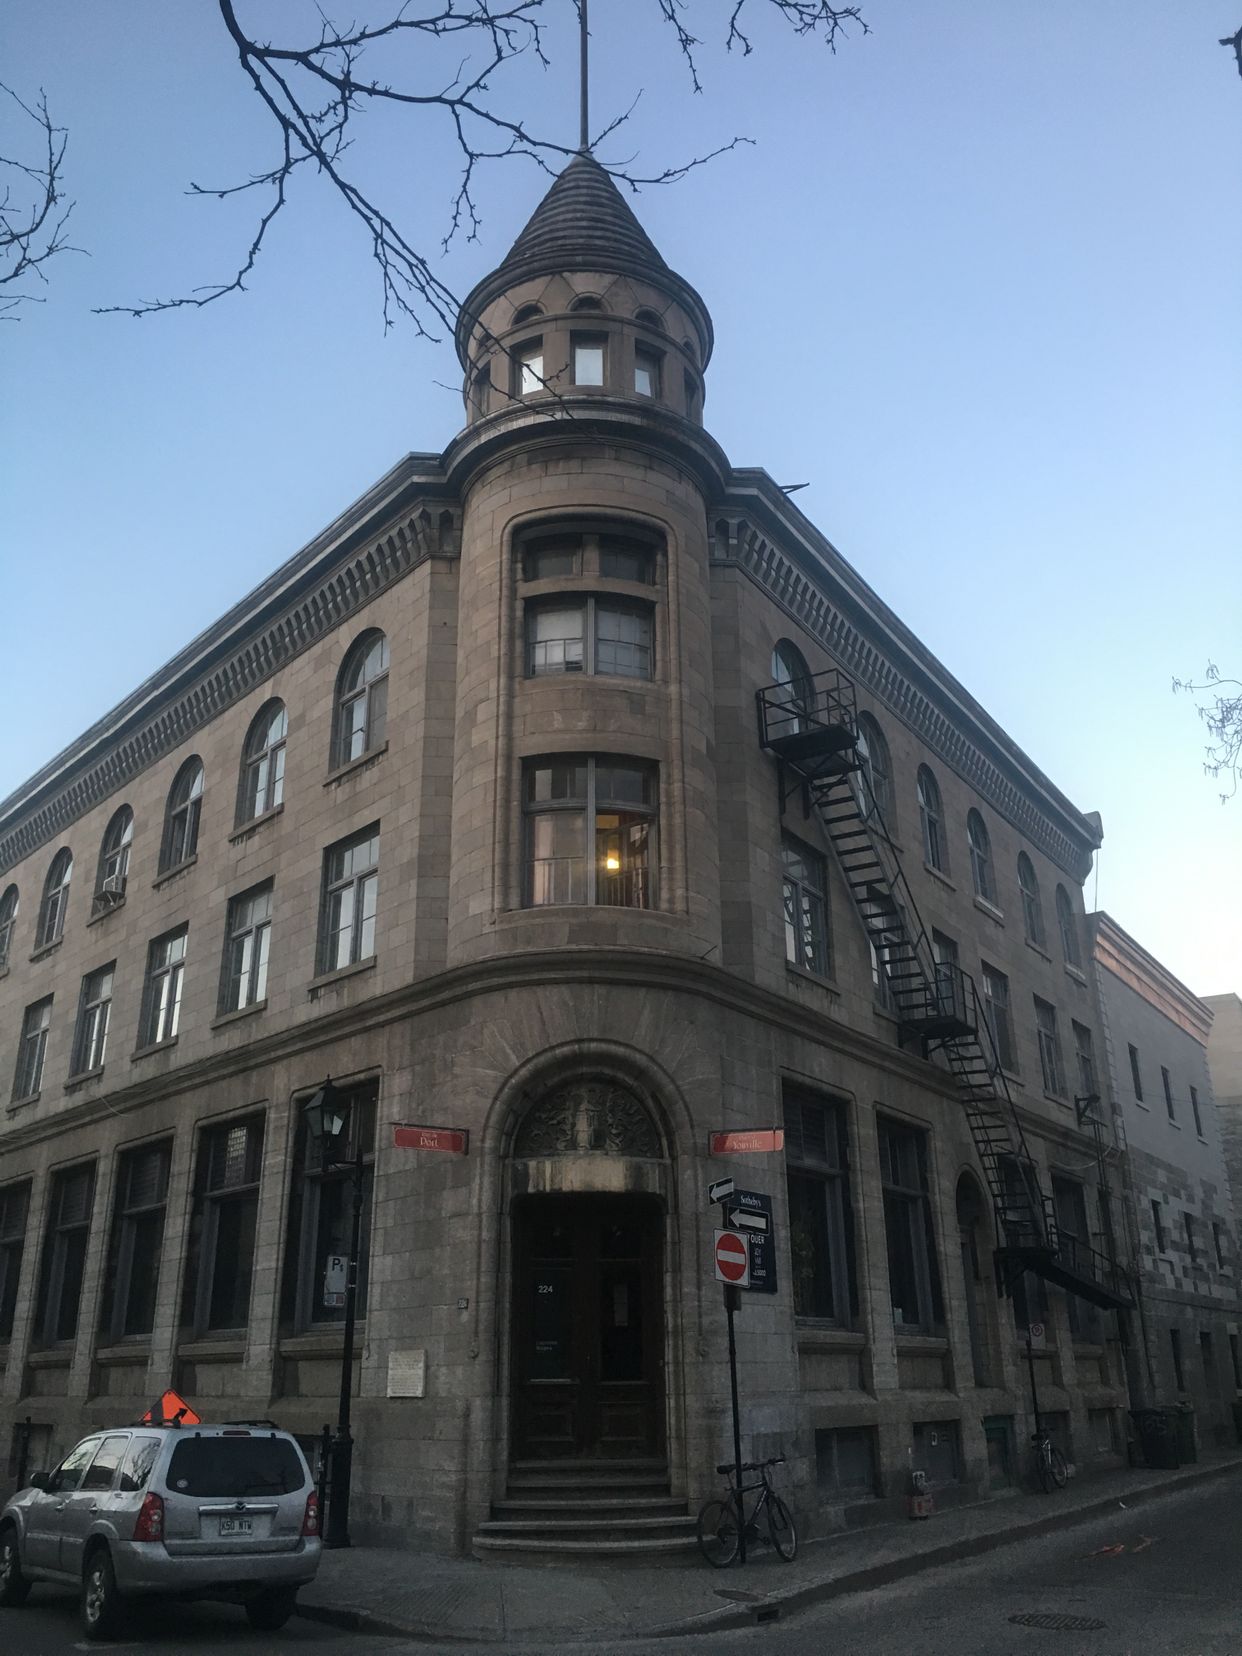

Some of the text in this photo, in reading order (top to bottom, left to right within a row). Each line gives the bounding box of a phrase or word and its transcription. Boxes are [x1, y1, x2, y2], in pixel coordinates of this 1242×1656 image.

[420, 1136, 439, 1148] Port
[732, 1138, 763, 1150] Youville
[750, 1234, 765, 1244] OUER
[538, 1285, 553, 1293] 224
